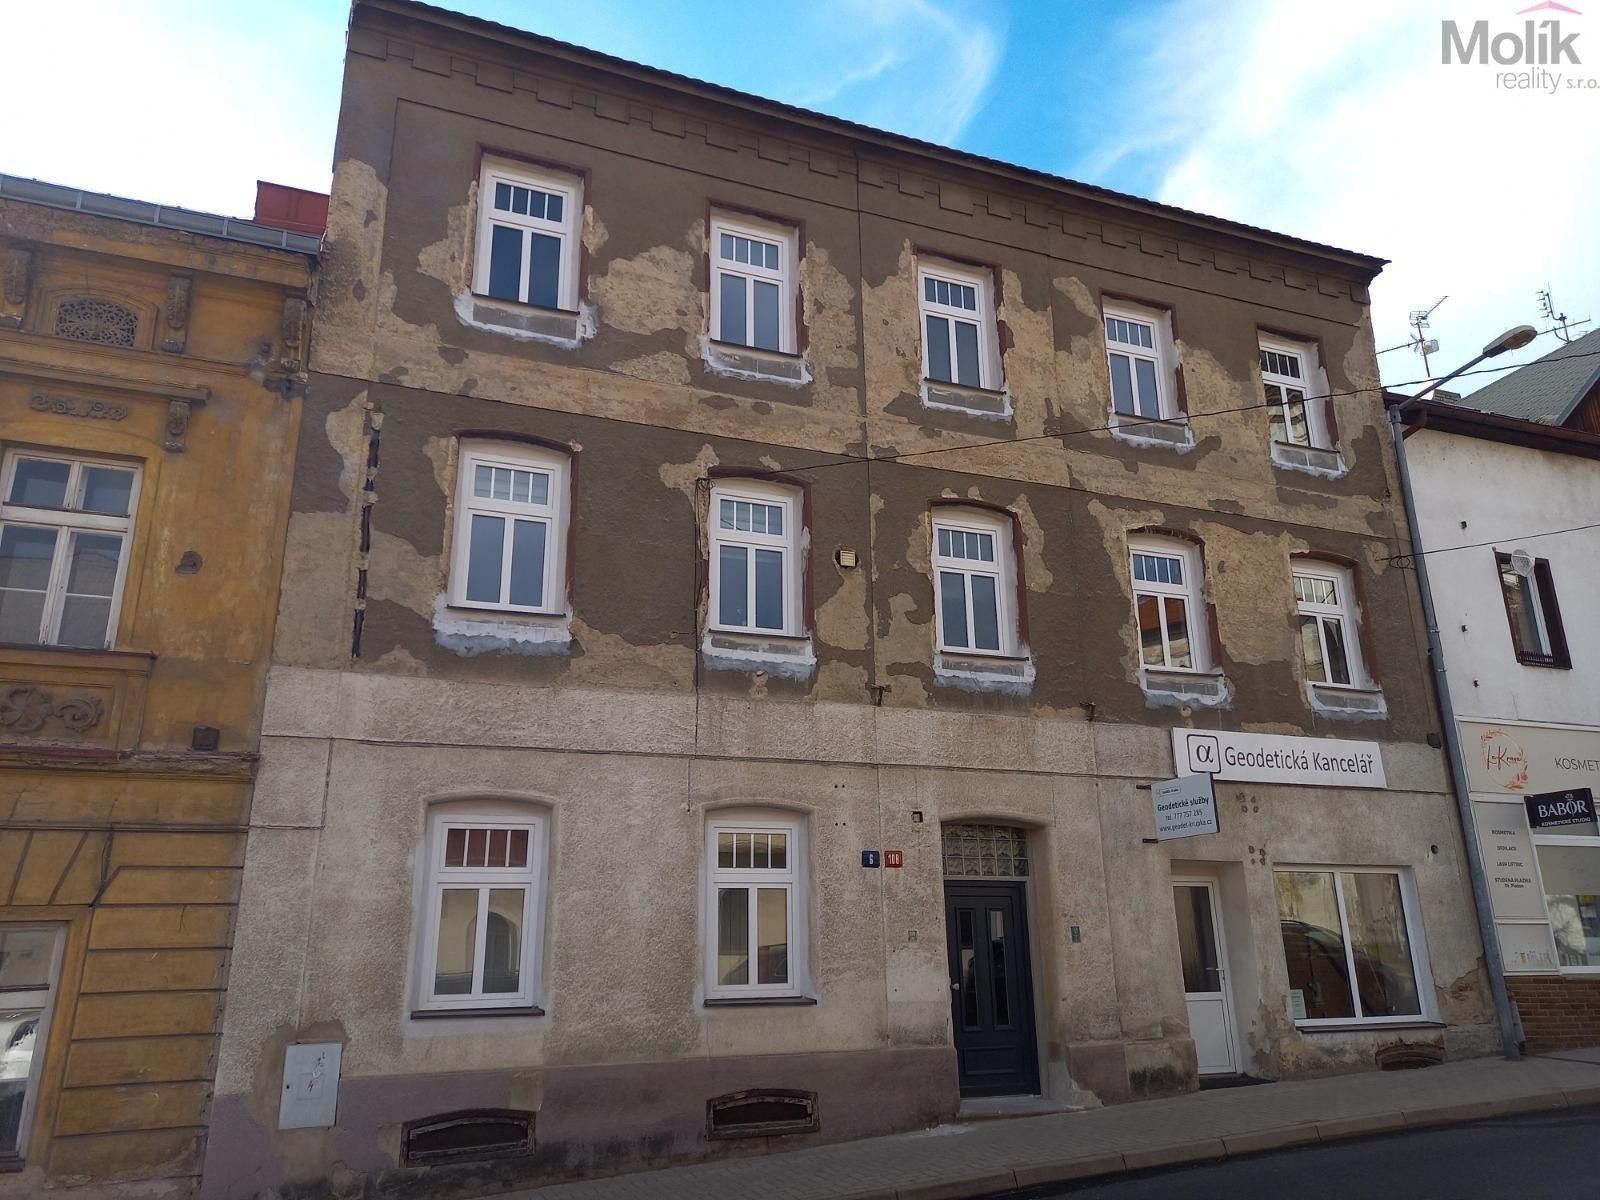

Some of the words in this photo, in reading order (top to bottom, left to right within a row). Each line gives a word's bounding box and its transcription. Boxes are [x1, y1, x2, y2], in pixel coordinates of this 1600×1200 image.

[1224, 746, 1309, 770] Geodetická
[1312, 752, 1373, 774] Kancelář
[1554, 757, 1600, 771] KOSMET
[1157, 798, 1189, 811] Geodetické
